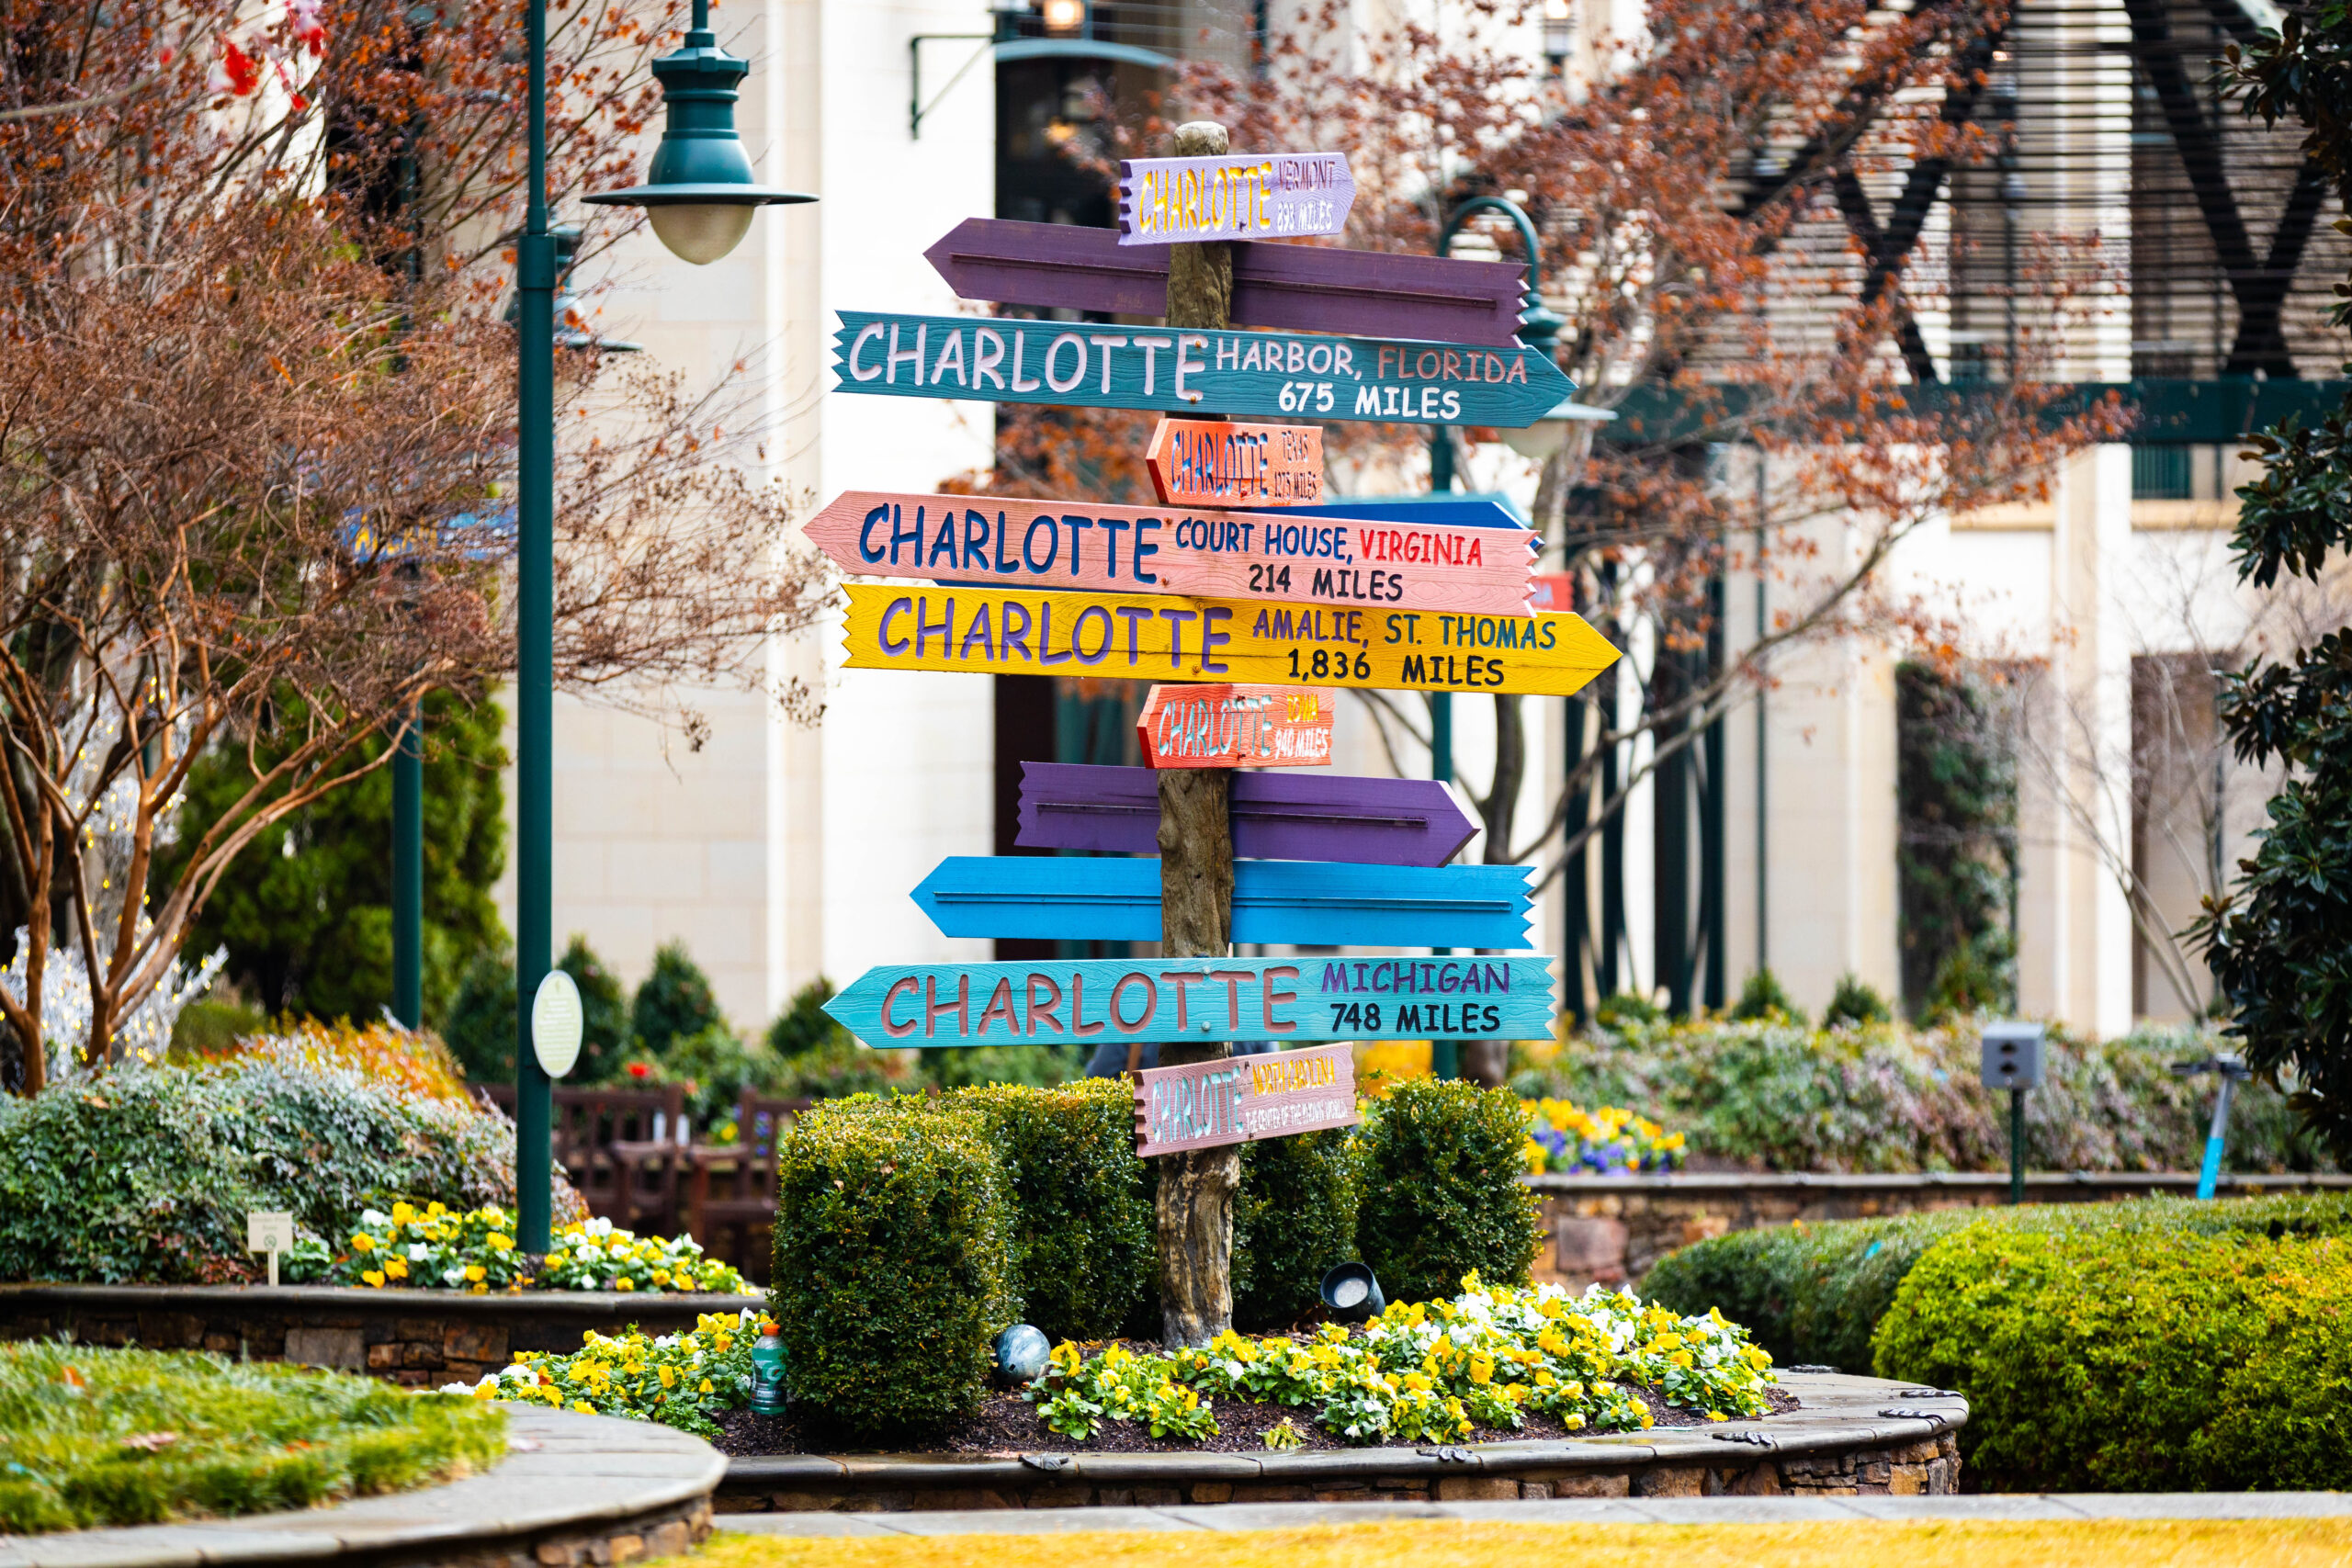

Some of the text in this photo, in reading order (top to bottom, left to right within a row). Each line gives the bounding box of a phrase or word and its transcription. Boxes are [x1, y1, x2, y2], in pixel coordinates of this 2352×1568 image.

[1139, 161, 1335, 234] CHARLOTTE VERMONT
[1277, 200, 1332, 231] 893 MILES
[849, 321, 1528, 401] CHARLOTTE HARBOR, FLORIDA
[1279, 381, 1461, 420] 675 MILES
[1171, 430, 1308, 498] CHARLOTTE TEXAS
[1294, 470, 1317, 501] MILES
[859, 502, 1482, 584] CHARLOTTE COURT HOUSE, VIRGINIA
[1249, 564, 1403, 601] 214 MILES
[878, 596, 1556, 673] CHARLOTTE AMALIE, ST. THOMAS
[1288, 648, 1504, 686] 1,836 MILES
[1158, 694, 1318, 757] CHARLOTTE IOWA
[1275, 728, 1329, 760] 940 MILES
[881, 962, 1510, 1038] CHARLOTTE MICHIGAN
[1329, 1002, 1500, 1033] 748 MILES
[1152, 1055, 1336, 1145] CHARLOTTE NORTH CAROLINA
[1245, 1110, 1258, 1133] THE
[1281, 1105, 1289, 1126] OF
[1290, 1103, 1302, 1125] THE
